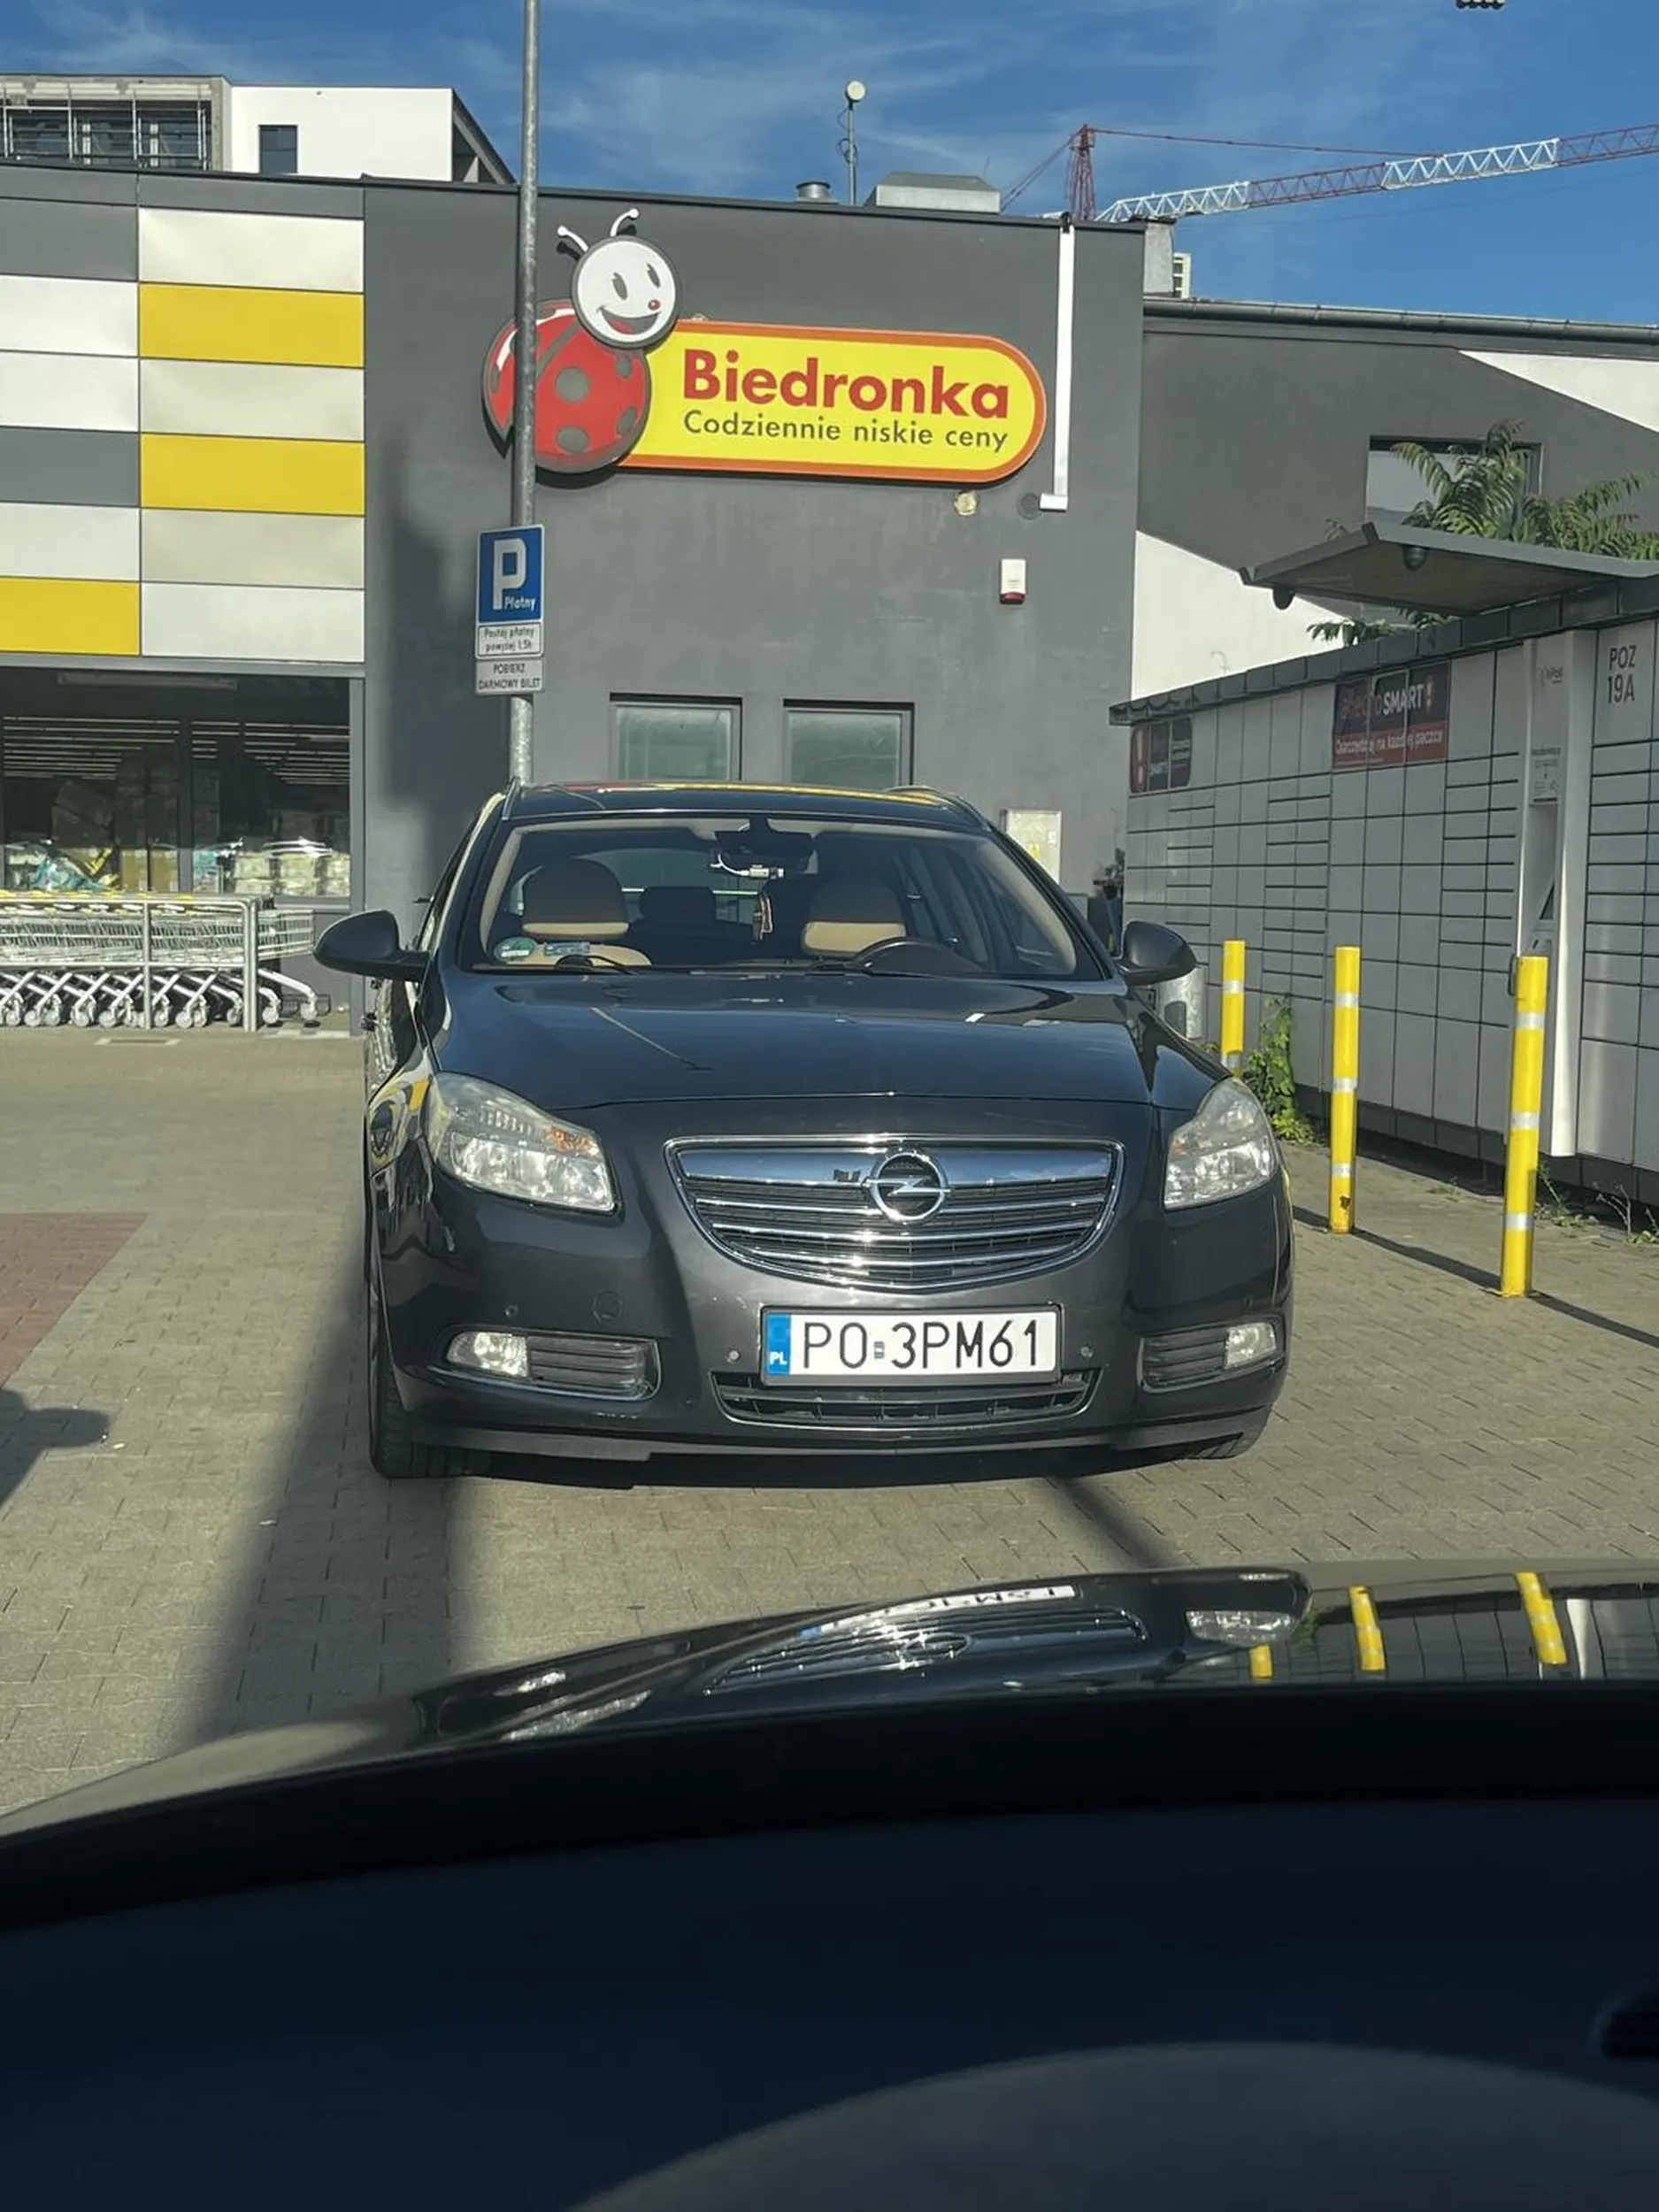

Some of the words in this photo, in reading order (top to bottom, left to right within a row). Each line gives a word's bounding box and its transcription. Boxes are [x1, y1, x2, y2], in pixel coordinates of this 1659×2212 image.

[683, 348, 1010, 419] Biedronka
[683, 409, 841, 442] Codziennie
[854, 418, 933, 445] niskie
[944, 427, 1009, 453] ceny
[492, 537, 527, 611] P
[1609, 644, 1636, 671] POZ
[479, 679, 519, 690] DARMOWY
[519, 677, 541, 688] BILET
[1607, 673, 1635, 704] 19A
[768, 1351, 787, 1365] PL
[803, 1321, 868, 1370] PO
[890, 1318, 1037, 1370] 3PM61
